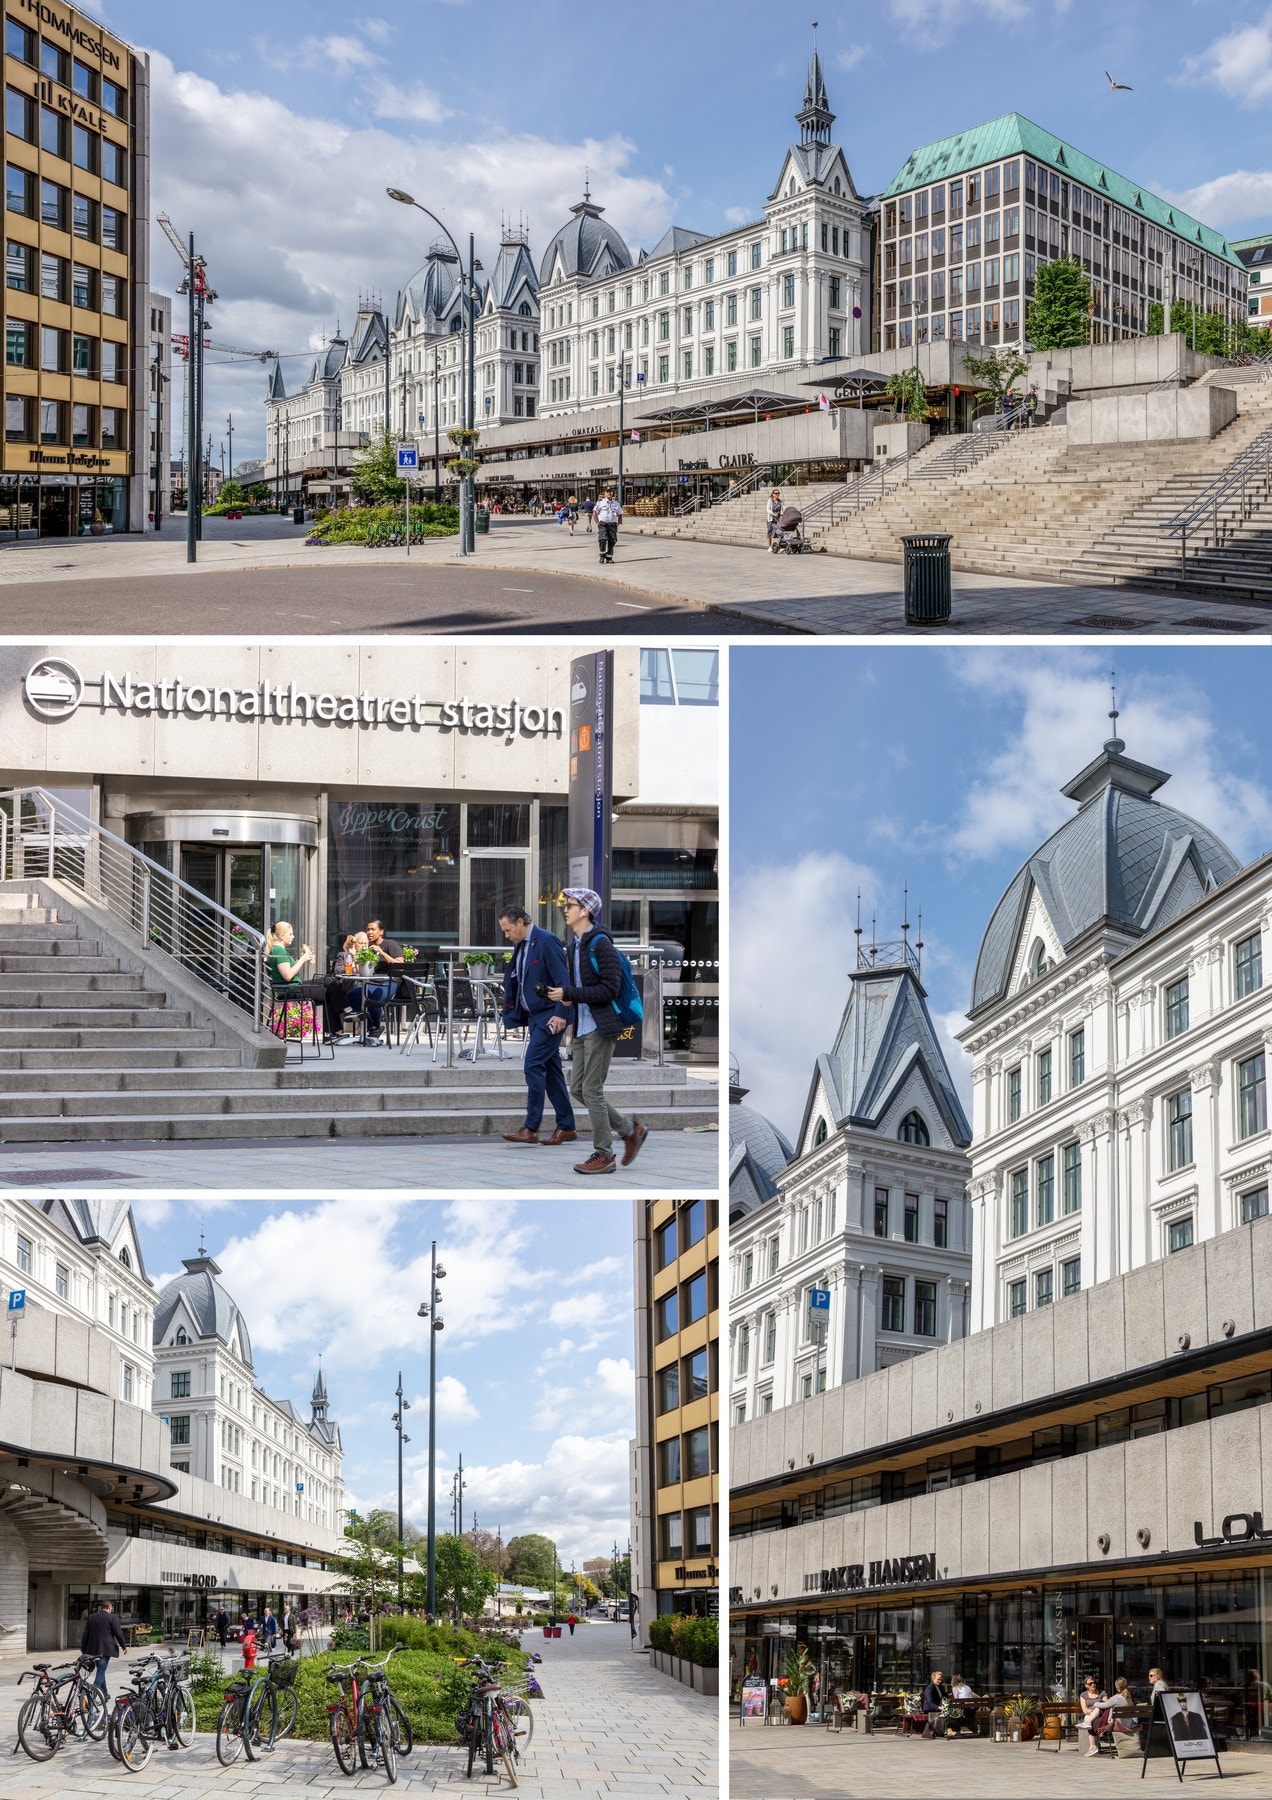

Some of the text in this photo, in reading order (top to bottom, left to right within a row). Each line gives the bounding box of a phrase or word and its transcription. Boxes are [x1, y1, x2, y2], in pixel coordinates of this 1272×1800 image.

[58, 94, 108, 133] KVALE
[572, 425, 604, 437] OMAKASE
[719, 453, 755, 468] CLAIRE
[104, 670, 567, 739] Nationaltheatret stasjon
[337, 802, 448, 836] Upper Crust
[816, 1292, 827, 1306] P
[191, 1573, 217, 1588] BORD
[820, 1552, 937, 1592] BAKER HANSEN
